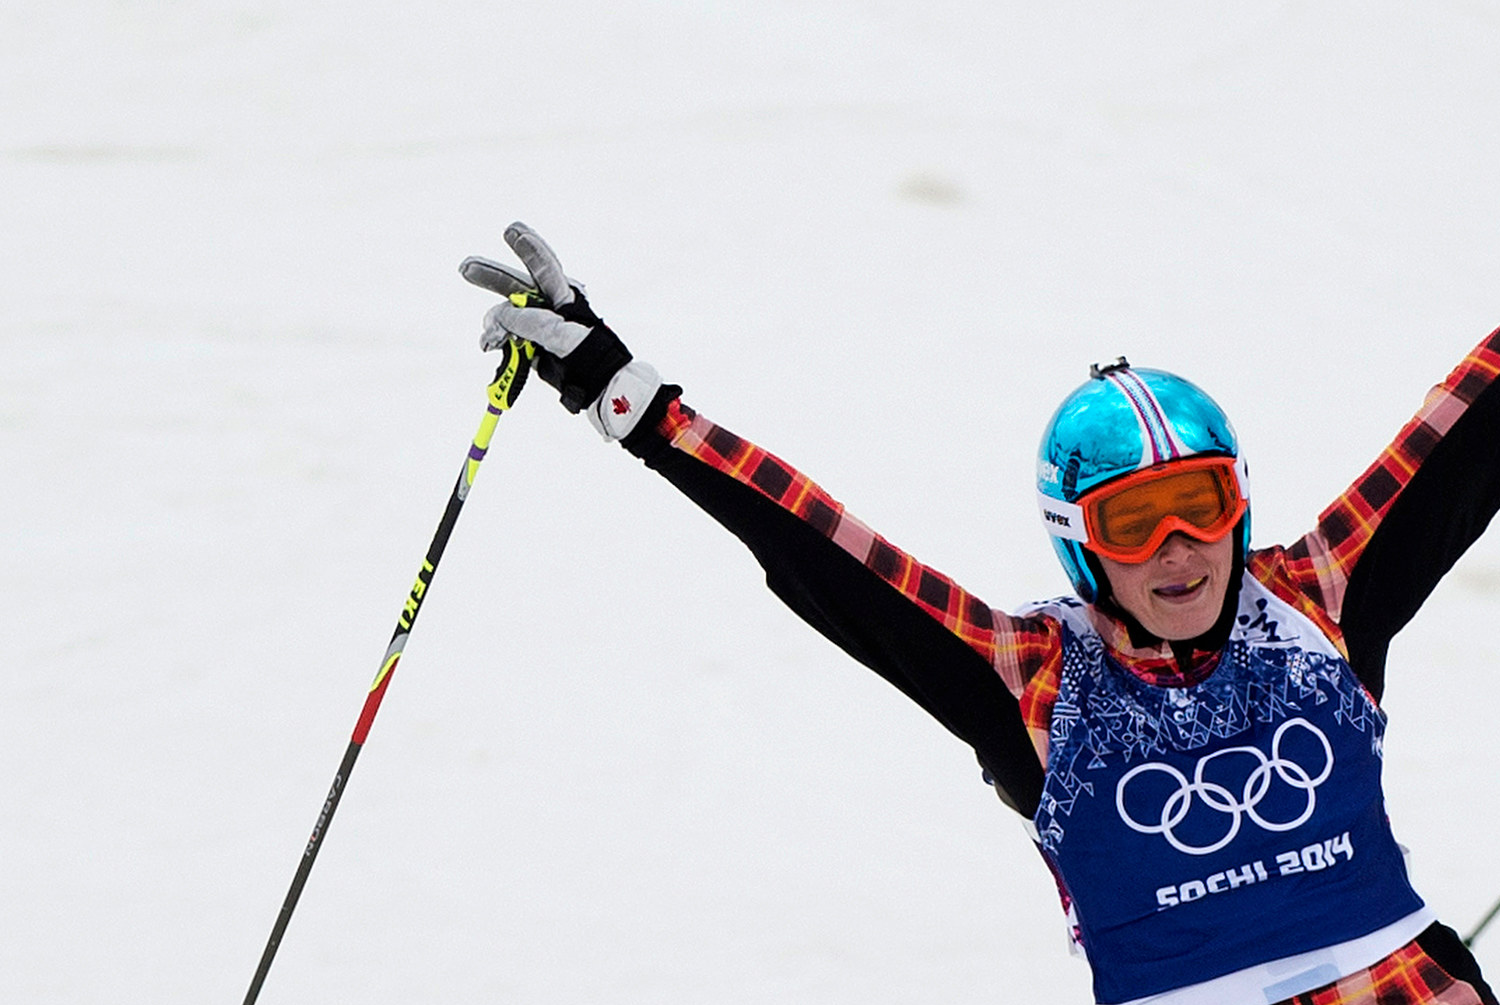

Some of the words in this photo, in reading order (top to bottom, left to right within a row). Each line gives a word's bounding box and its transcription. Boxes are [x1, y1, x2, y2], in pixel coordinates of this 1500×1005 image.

[494, 367, 514, 400] LEKI
[399, 557, 435, 630] LEKI
[1156, 860, 1268, 912] SOCHI
[1275, 831, 1354, 876] 2014
